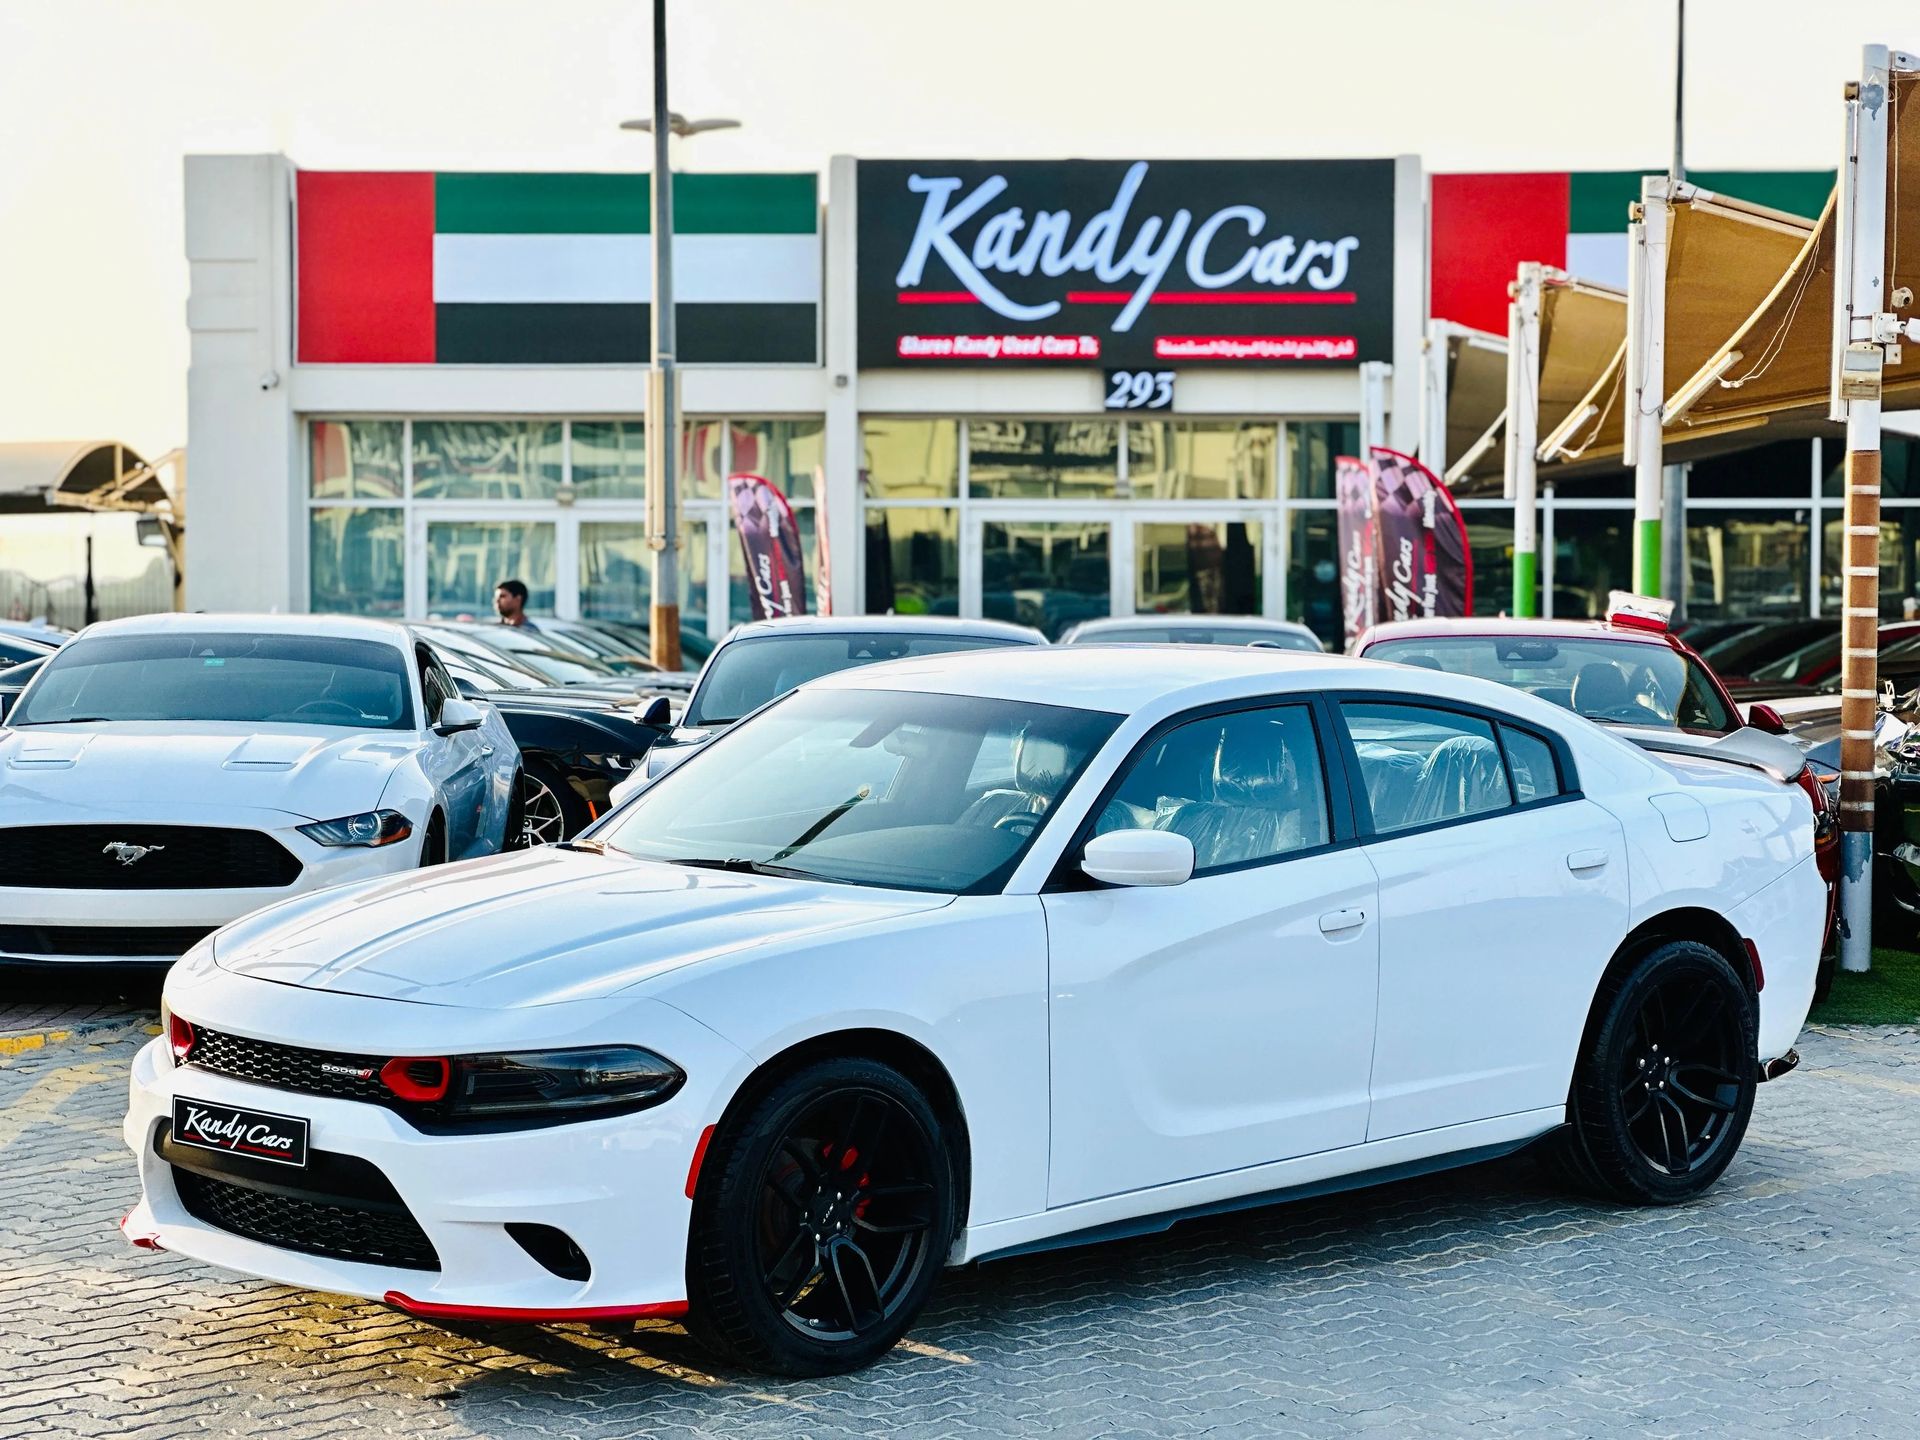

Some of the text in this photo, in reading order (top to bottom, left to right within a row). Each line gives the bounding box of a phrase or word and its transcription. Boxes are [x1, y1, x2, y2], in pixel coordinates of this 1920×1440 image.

[895, 161, 1359, 332] Kandy Cars
[757, 553, 772, 594] Cars
[1393, 536, 1413, 583] Cars
[321, 1063, 364, 1076] DODGE
[184, 1106, 294, 1150] Kandy Cars
